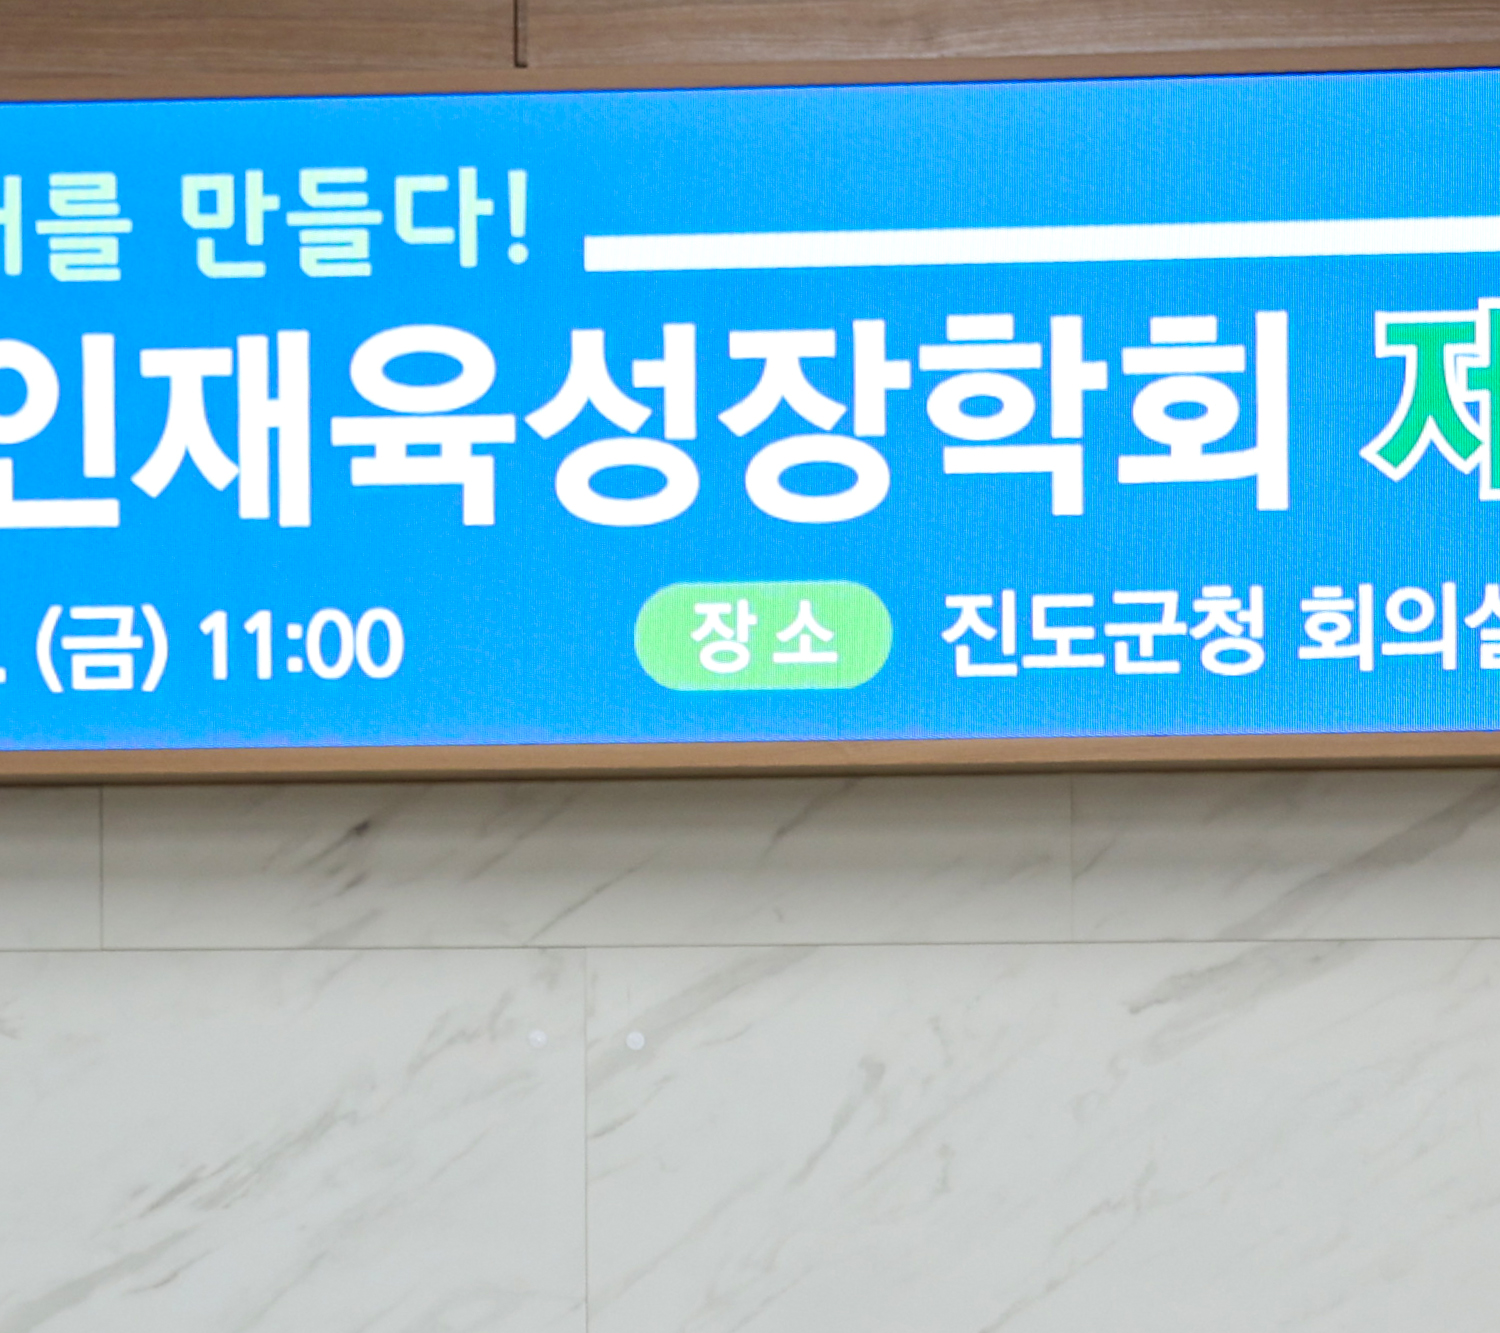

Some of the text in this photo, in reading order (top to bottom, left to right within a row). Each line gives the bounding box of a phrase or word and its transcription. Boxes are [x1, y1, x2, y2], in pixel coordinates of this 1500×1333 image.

[180, 166, 530, 279] 만들다!
[36, 603, 169, 693] (금)
[200, 606, 404, 682] 11:00
[941, 584, 1266, 677] 진도군청
